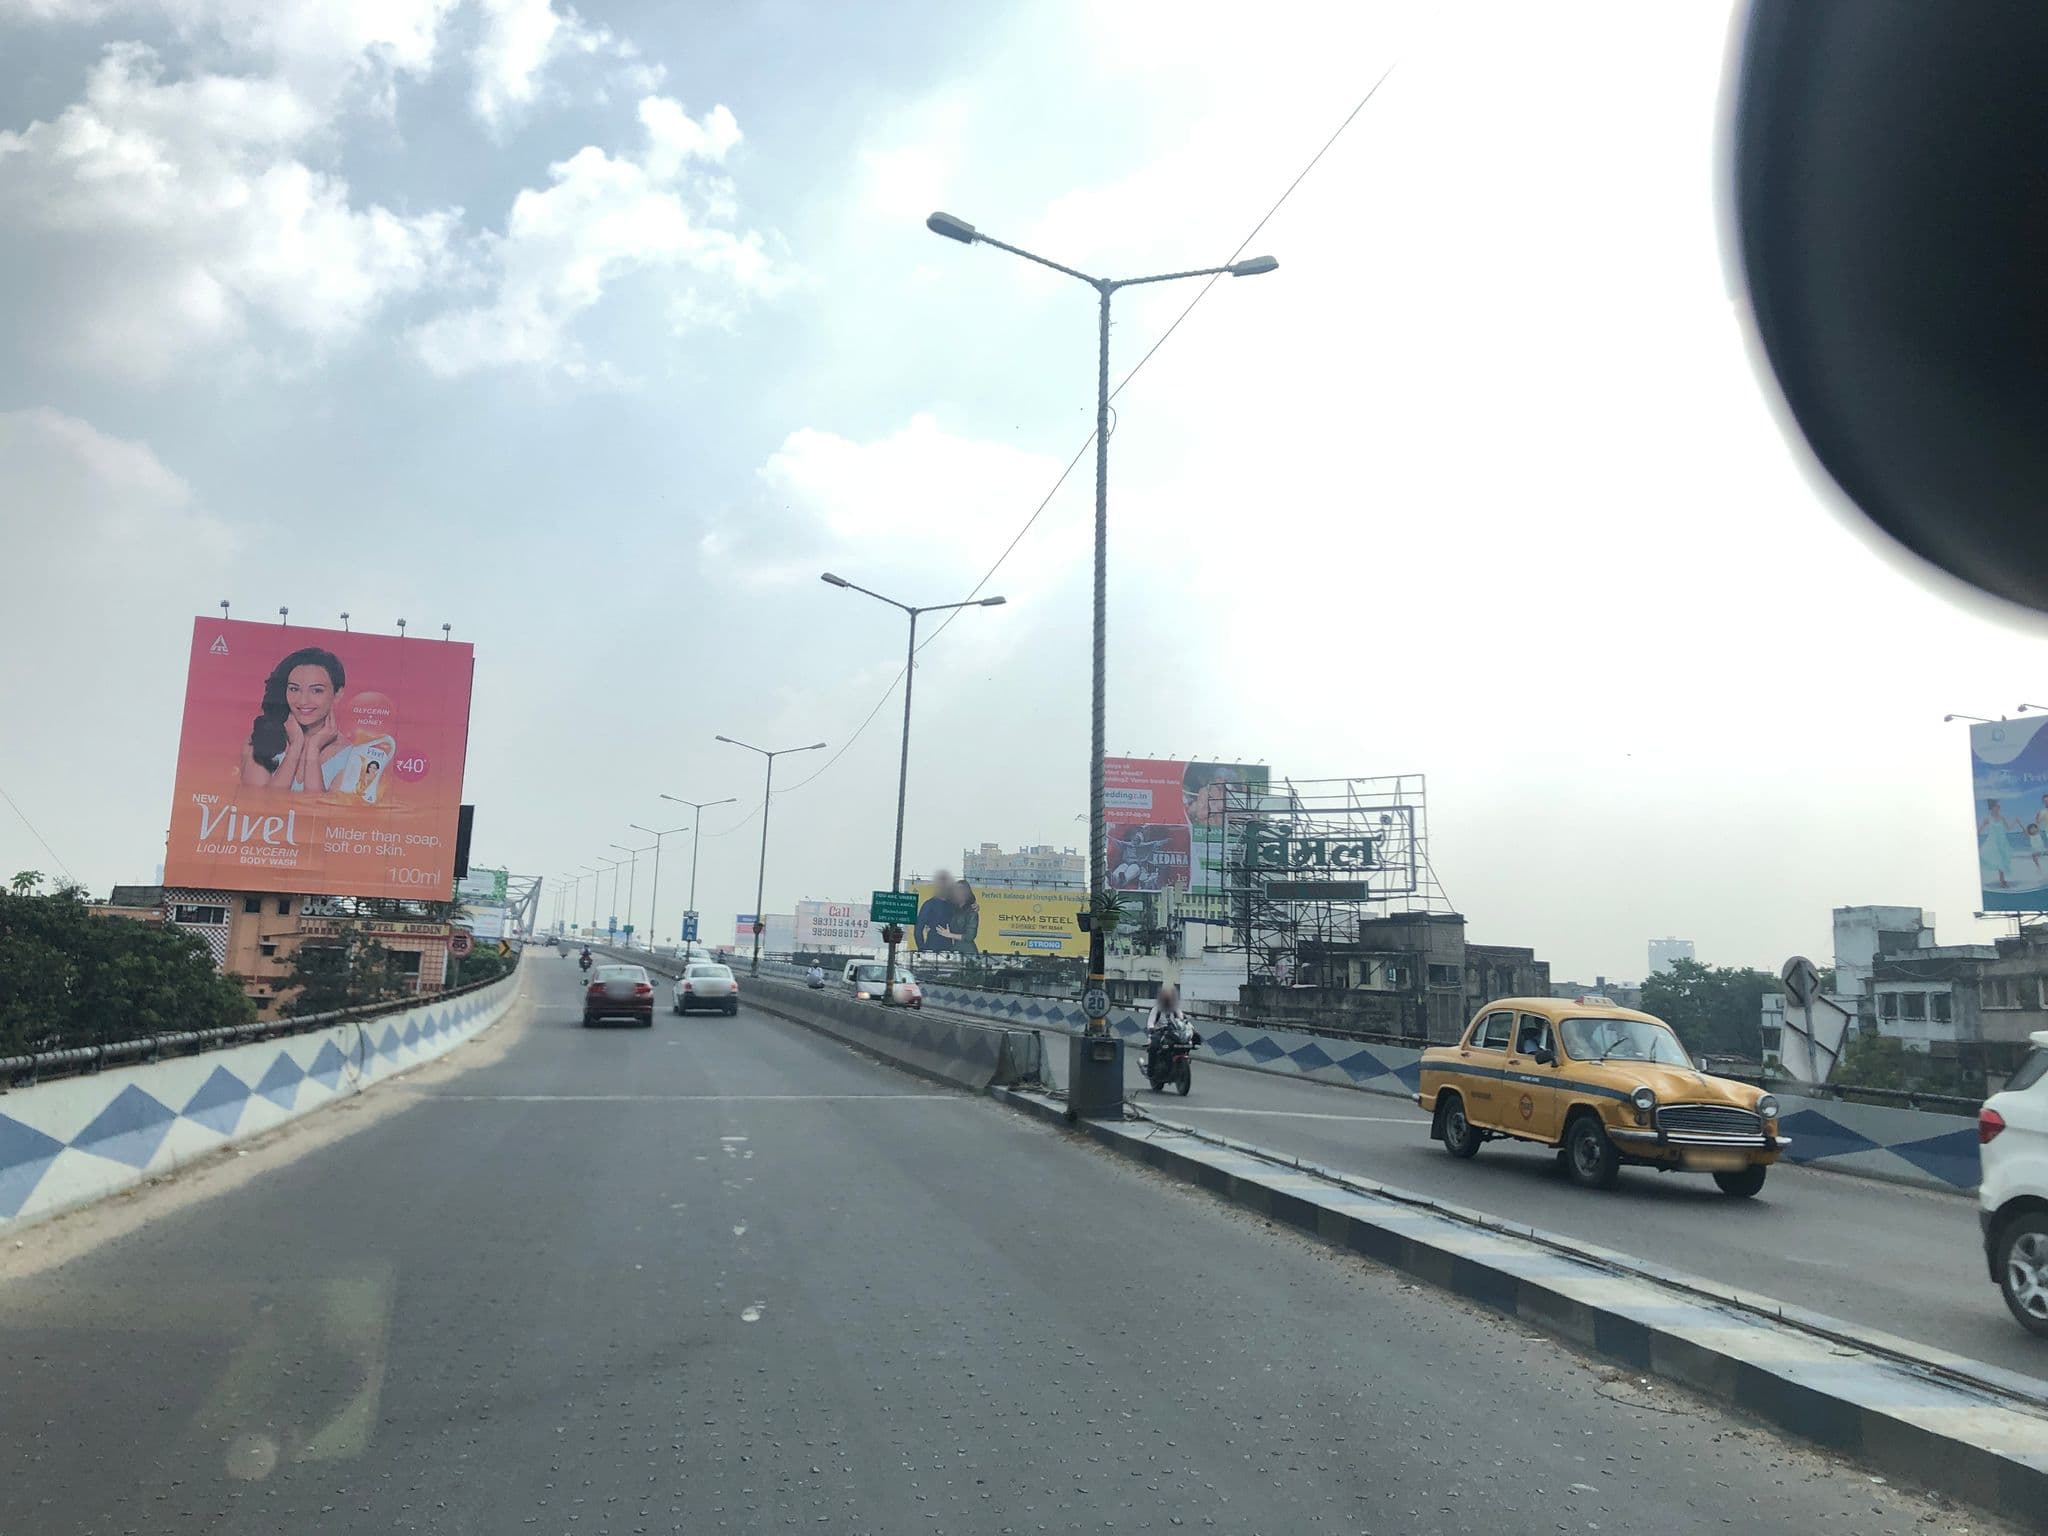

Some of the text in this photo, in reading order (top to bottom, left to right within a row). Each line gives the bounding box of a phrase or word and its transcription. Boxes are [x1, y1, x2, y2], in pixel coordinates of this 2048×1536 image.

[353, 707, 390, 716] GLYCERIN
[357, 718, 383, 726] HONEY
[192, 793, 219, 804] NEW
[198, 803, 298, 846] Vivel
[325, 826, 442, 848] Milder than soap,
[196, 843, 299, 857] LIQUID GLYCERIN
[324, 841, 406, 857] soft on skin.
[240, 856, 297, 866] BODY WASH
[389, 867, 441, 885] 100ml
[829, 906, 850, 917] Call
[998, 914, 1074, 925] SHYAM STEEL
[1028, 940, 1061, 949] STRONG
[1088, 997, 1105, 1010] 20
